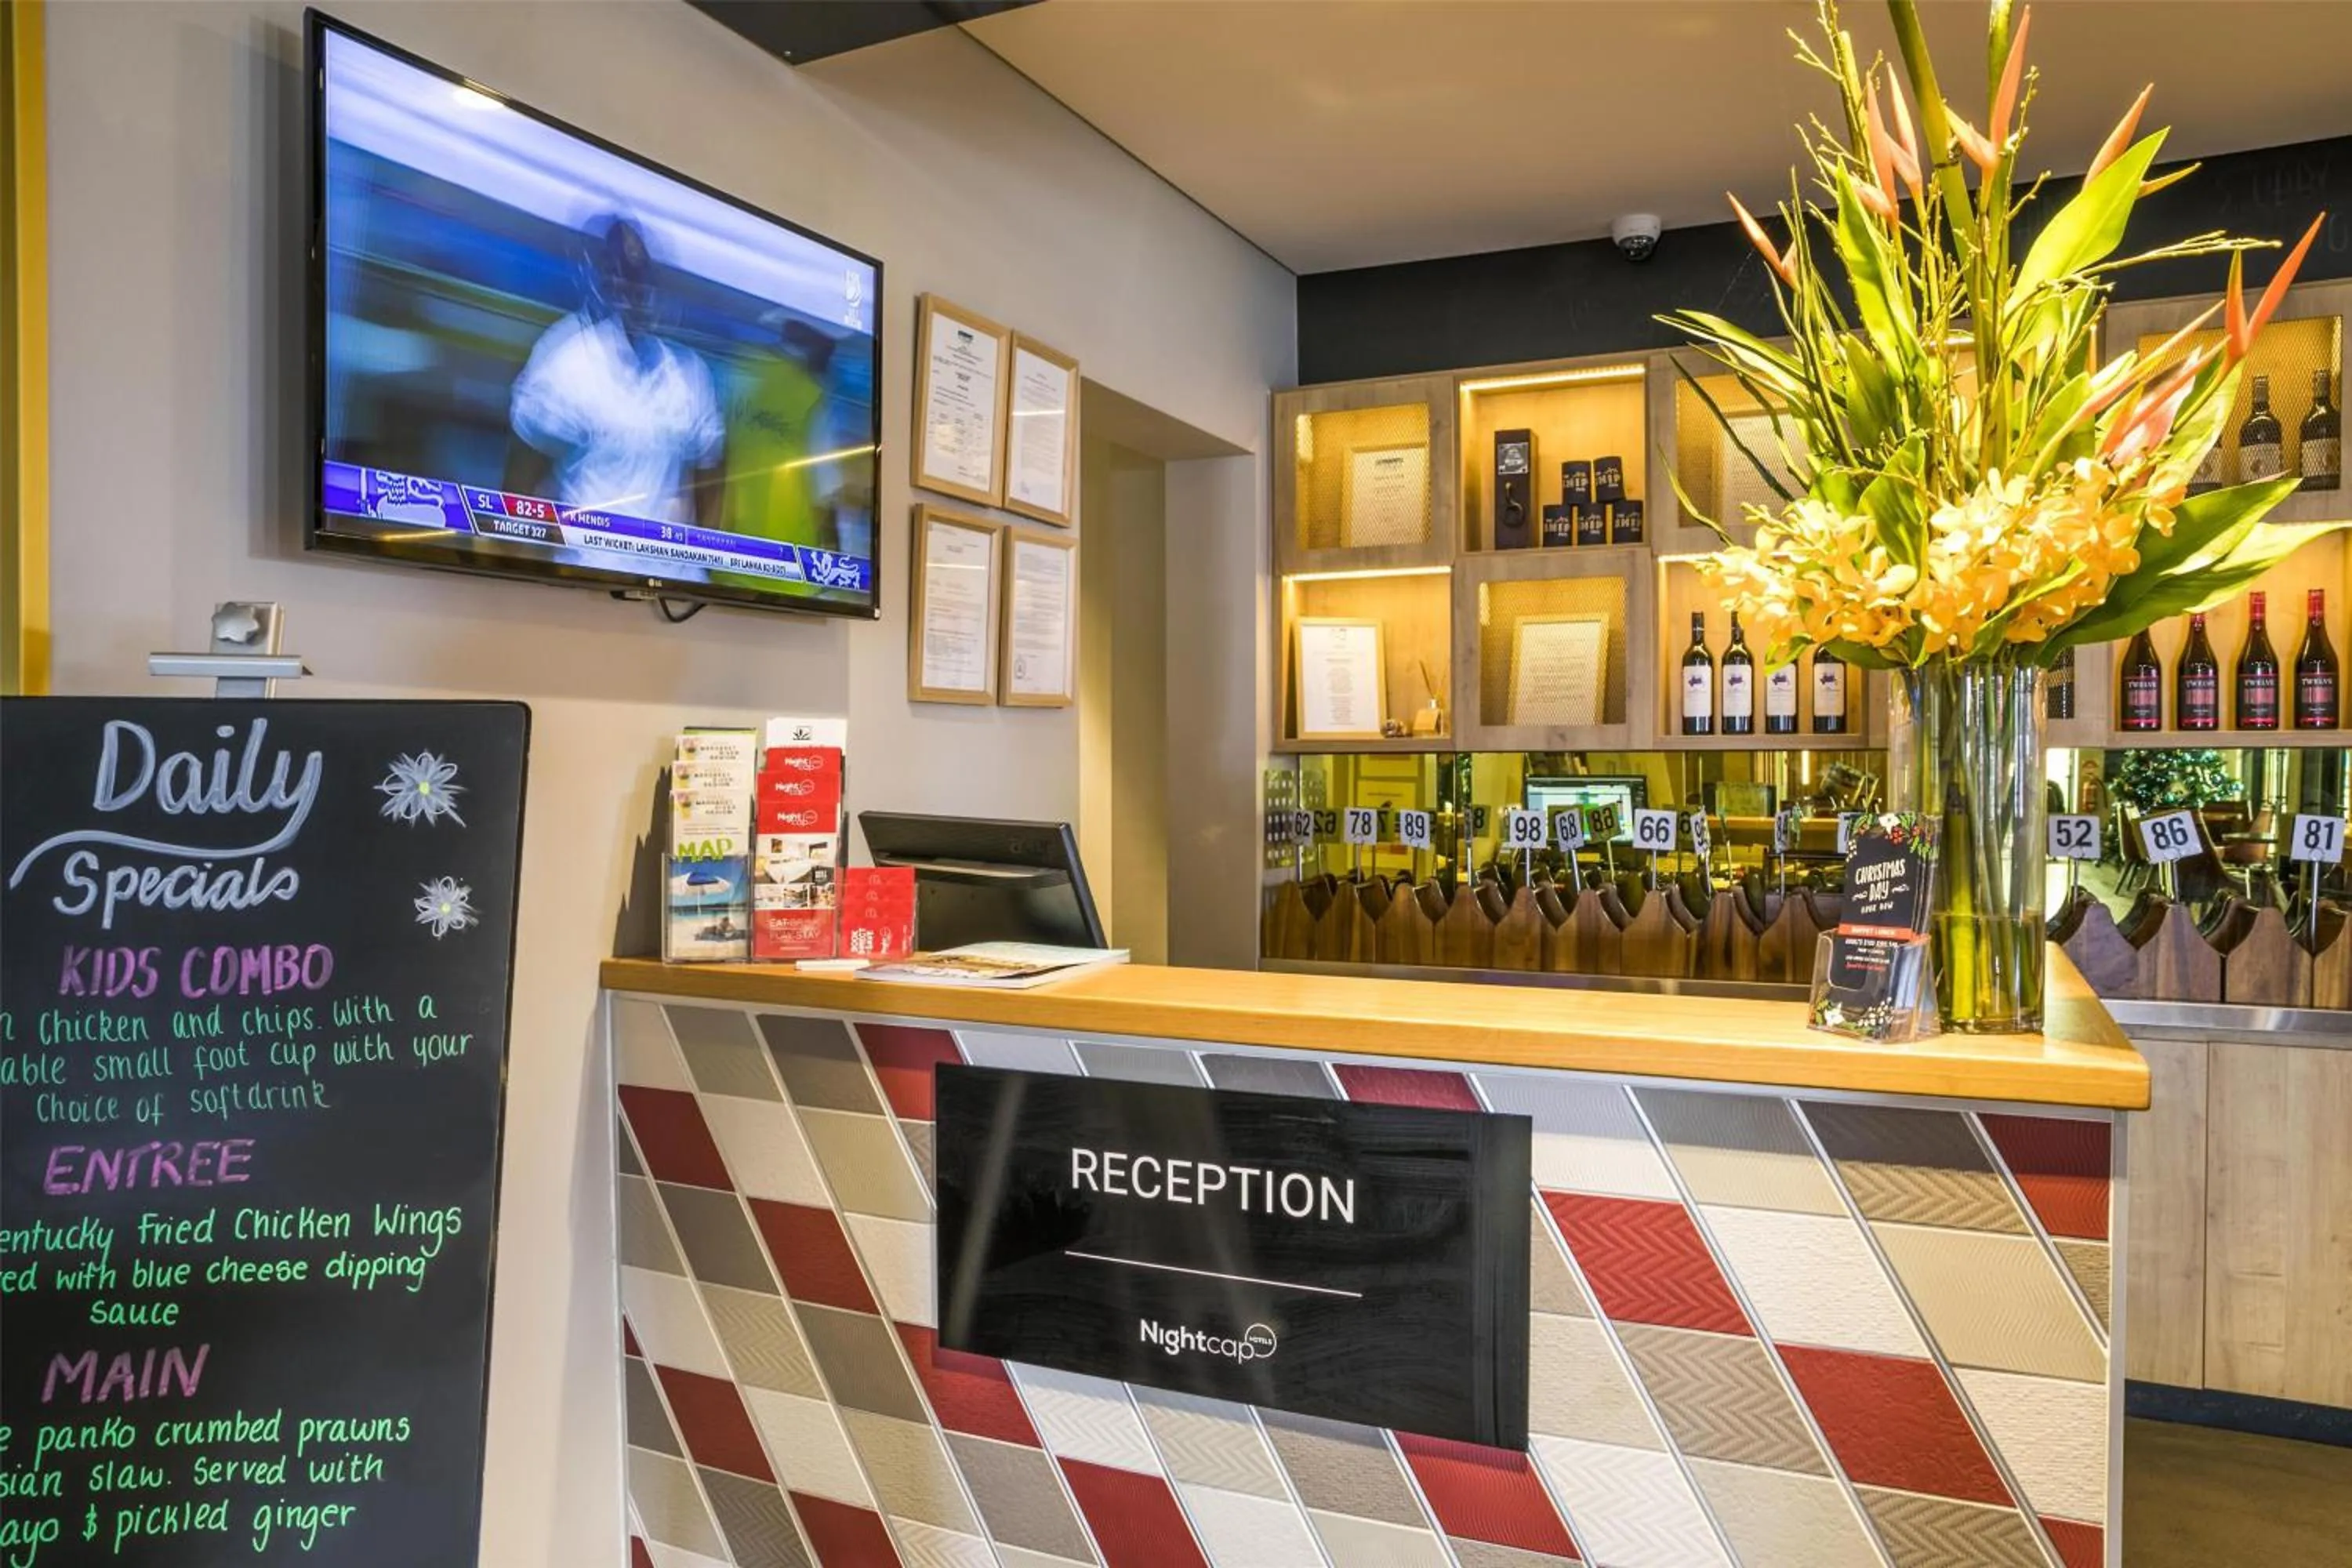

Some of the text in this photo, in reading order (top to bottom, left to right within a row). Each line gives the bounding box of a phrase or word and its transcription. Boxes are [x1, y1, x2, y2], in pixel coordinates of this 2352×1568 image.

[477, 493, 493, 510] SL
[516, 500, 545, 518] 82-5
[493, 519, 530, 536] TARGET
[583, 534, 603, 546] LAST
[2185, 680, 2216, 688] TWELVE
[93, 717, 322, 856] Daily
[1295, 812, 1310, 837] 62
[1349, 811, 1372, 836] 78
[1404, 813, 1425, 839] 89
[1515, 816, 1541, 841] 98
[1559, 813, 1578, 841] 68
[1639, 815, 1669, 844] 66
[2056, 818, 2092, 848] 52
[2150, 817, 2189, 851] 86
[2303, 818, 2336, 850] 81
[677, 837, 733, 863] MAP
[1855, 858, 1906, 885] CHRISTMAS
[53, 851, 299, 930] Specials
[1869, 880, 1889, 902] DAY
[58, 943, 334, 999] KIDS COMBO
[172, 1004, 225, 1039] and
[418, 995, 438, 1019] a
[0, 1032, 474, 1087] able small foot cup with your
[136, 1093, 165, 1127] of
[44, 1138, 256, 1196] ENTREE
[1070, 1146, 1356, 1225] RECEPTION
[0, 1216, 114, 1261] entucky
[234, 1206, 351, 1240] Chicken
[374, 1203, 463, 1257] Wings
[0, 1250, 428, 1293] ed with blue cheese dipping
[1140, 1318, 1254, 1365] Nightcap
[42, 1344, 210, 1403] MAIN
[34, 1416, 136, 1473] panko
[155, 1407, 282, 1447] crumbed
[297, 1417, 411, 1458] prawns
[0, 1463, 63, 1498] sian
[309, 1452, 383, 1483] with
[0, 1518, 59, 1568] ayo
[114, 1498, 230, 1554] pickled
[252, 1498, 356, 1552] ginger
